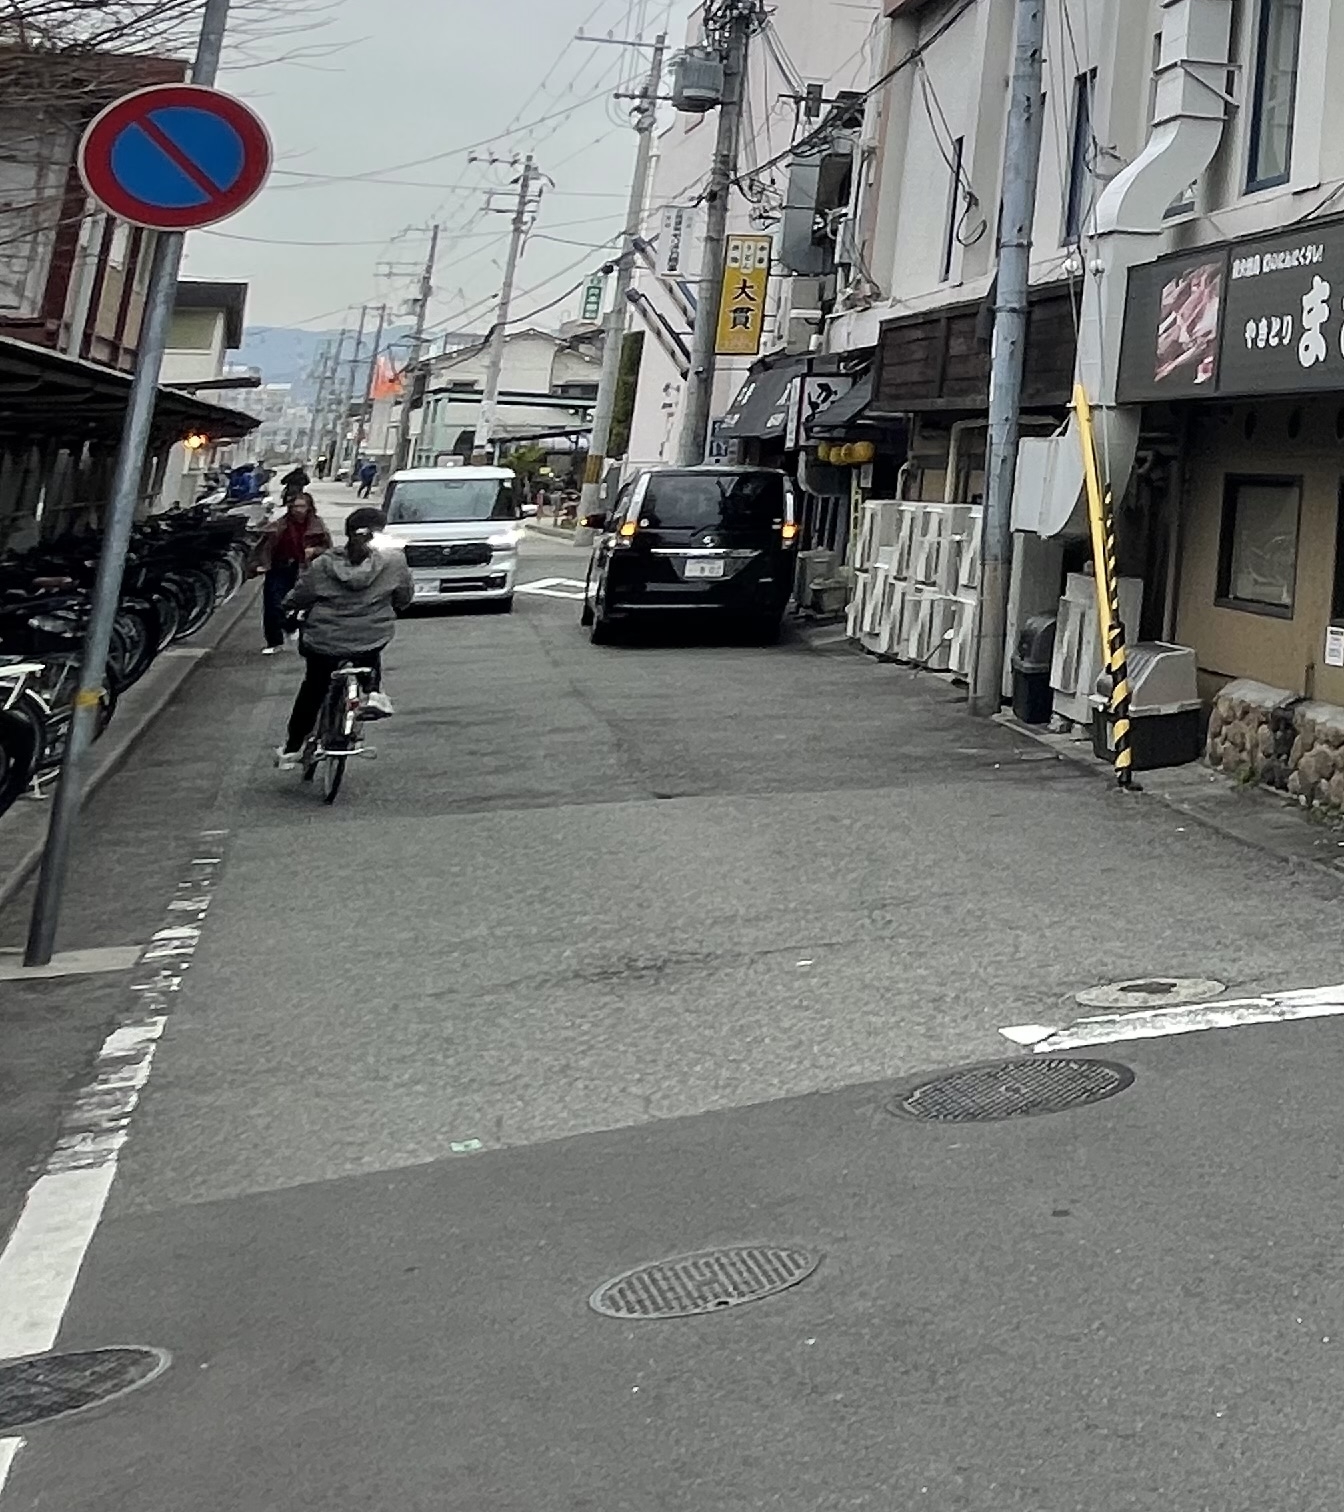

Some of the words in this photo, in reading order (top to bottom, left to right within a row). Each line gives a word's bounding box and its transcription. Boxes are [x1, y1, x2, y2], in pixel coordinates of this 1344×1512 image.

[727, 278, 757, 330] 大貫
[1244, 311, 1293, 350] やきとり
